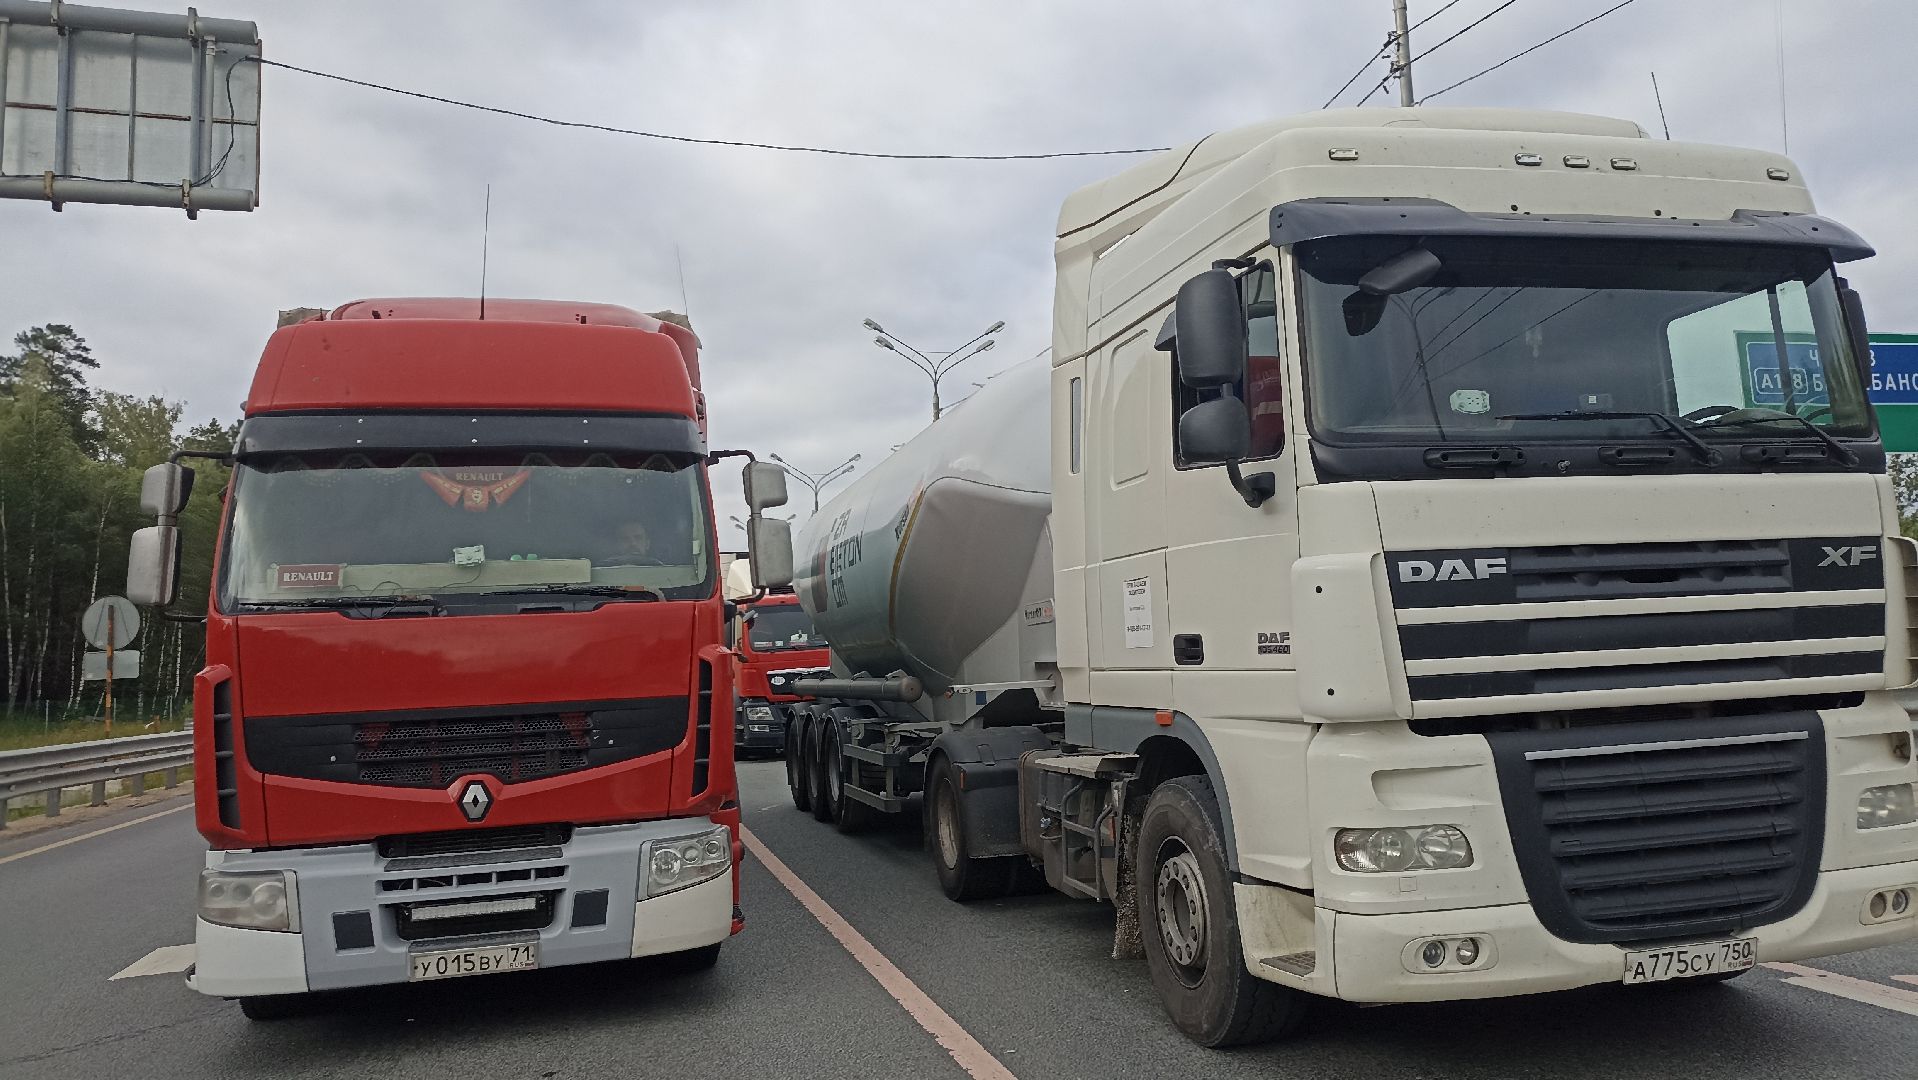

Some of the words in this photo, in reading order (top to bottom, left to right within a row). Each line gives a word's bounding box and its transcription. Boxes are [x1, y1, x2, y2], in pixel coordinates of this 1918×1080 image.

[1761, 373, 1806, 389] А18
[456, 472, 503, 481] RENAULT
[1817, 545, 1877, 567] XF
[283, 571, 334, 582] RENAULT
[1398, 558, 1507, 583] DAF
[1257, 631, 1290, 644] DAF
[510, 946, 531, 962] 71
[1721, 941, 1751, 963] 750
[509, 961, 525, 969] RUS
[1727, 961, 1744, 969] RUS
